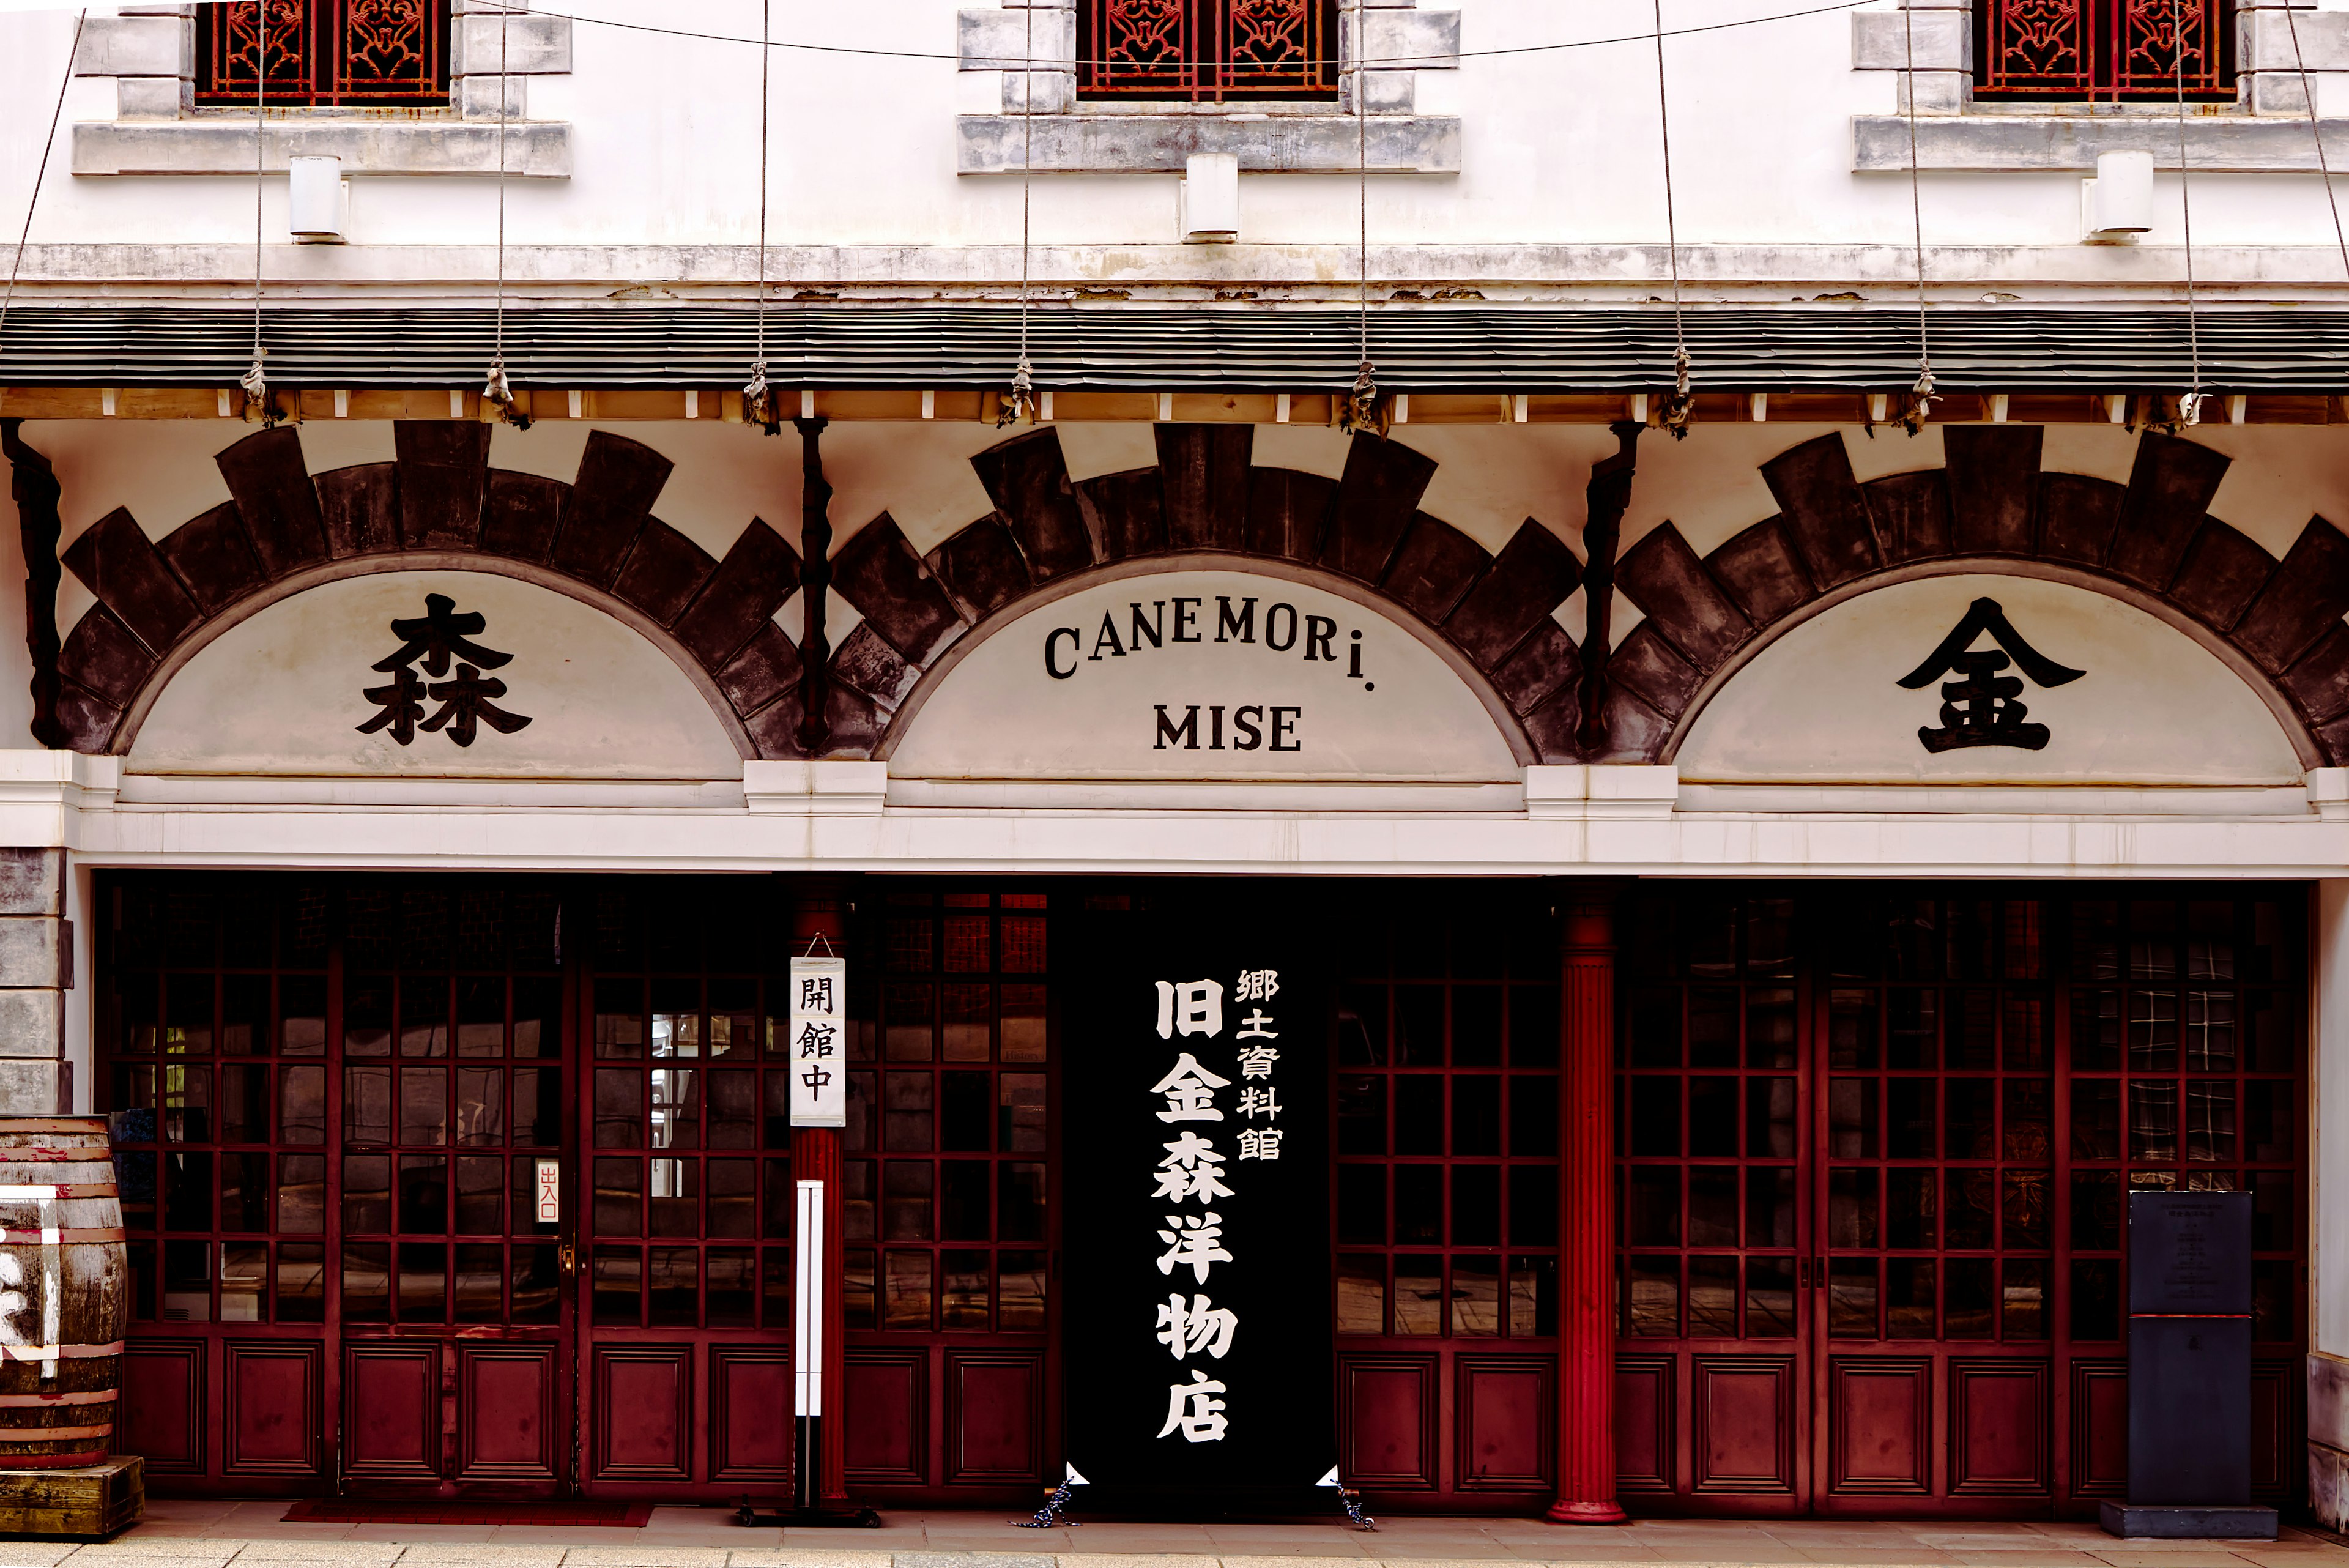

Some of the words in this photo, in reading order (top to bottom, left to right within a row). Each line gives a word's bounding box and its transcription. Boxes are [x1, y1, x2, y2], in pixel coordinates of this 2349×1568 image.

[355, 593, 533, 748] 森
[1153, 705, 1301, 752] MISE
[1895, 596, 2087, 754] 金
[796, 977, 837, 1102] 開館中
[1234, 969, 1283, 1161] 郷土資料館
[540, 1167, 557, 1218] 出入口
[1150, 978, 1238, 1443] 旧金森洋物店
